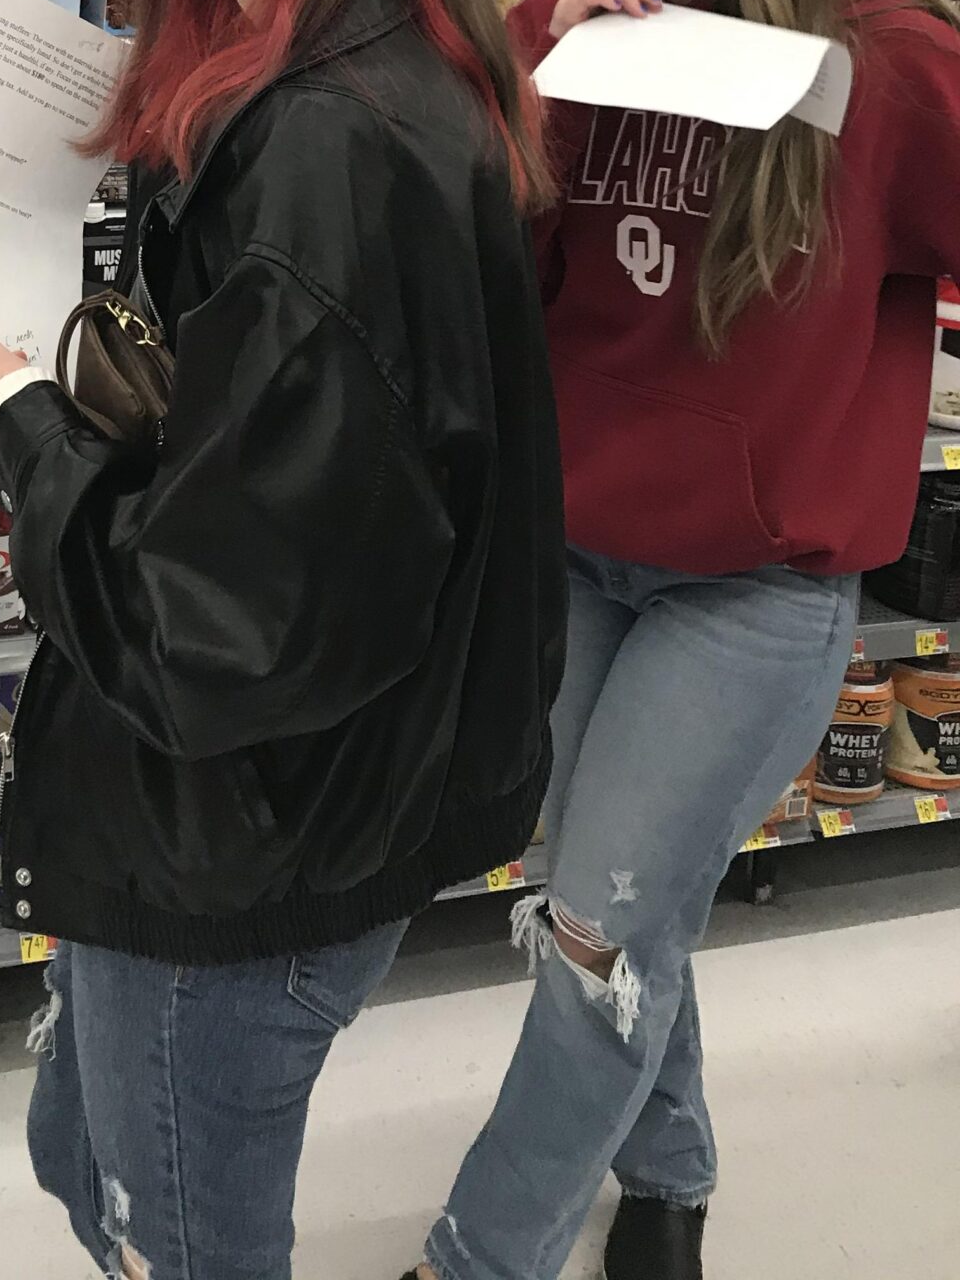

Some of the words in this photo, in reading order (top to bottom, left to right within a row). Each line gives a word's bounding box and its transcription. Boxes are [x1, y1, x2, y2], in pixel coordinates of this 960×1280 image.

[616, 214, 675, 297] OU
[829, 732, 880, 748] WHEY
[829, 747, 878, 759] PROTEIN
